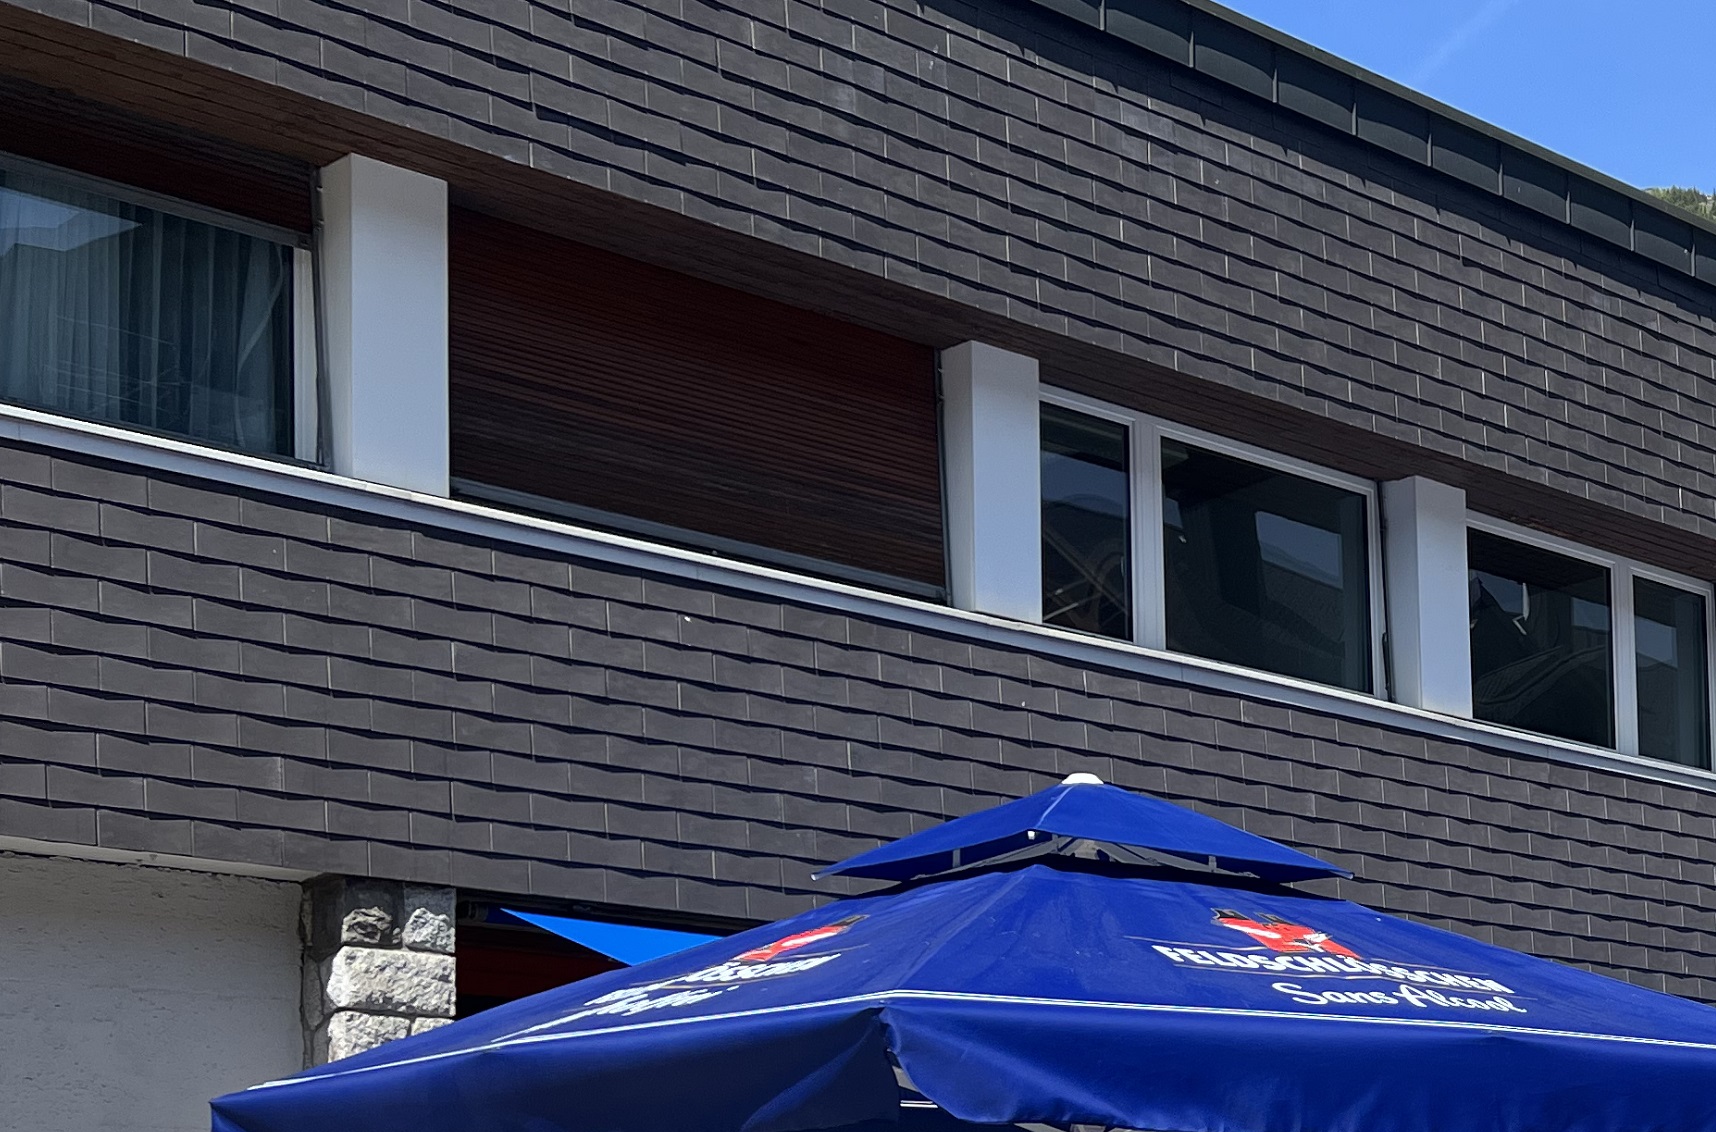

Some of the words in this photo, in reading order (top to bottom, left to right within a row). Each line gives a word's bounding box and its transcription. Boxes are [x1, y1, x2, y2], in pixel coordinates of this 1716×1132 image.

[1151, 945, 1515, 994] FELDSCHLÖSSCHEN
[1271, 981, 1399, 1005] Sans
[1393, 983, 1528, 1014] Alcool
